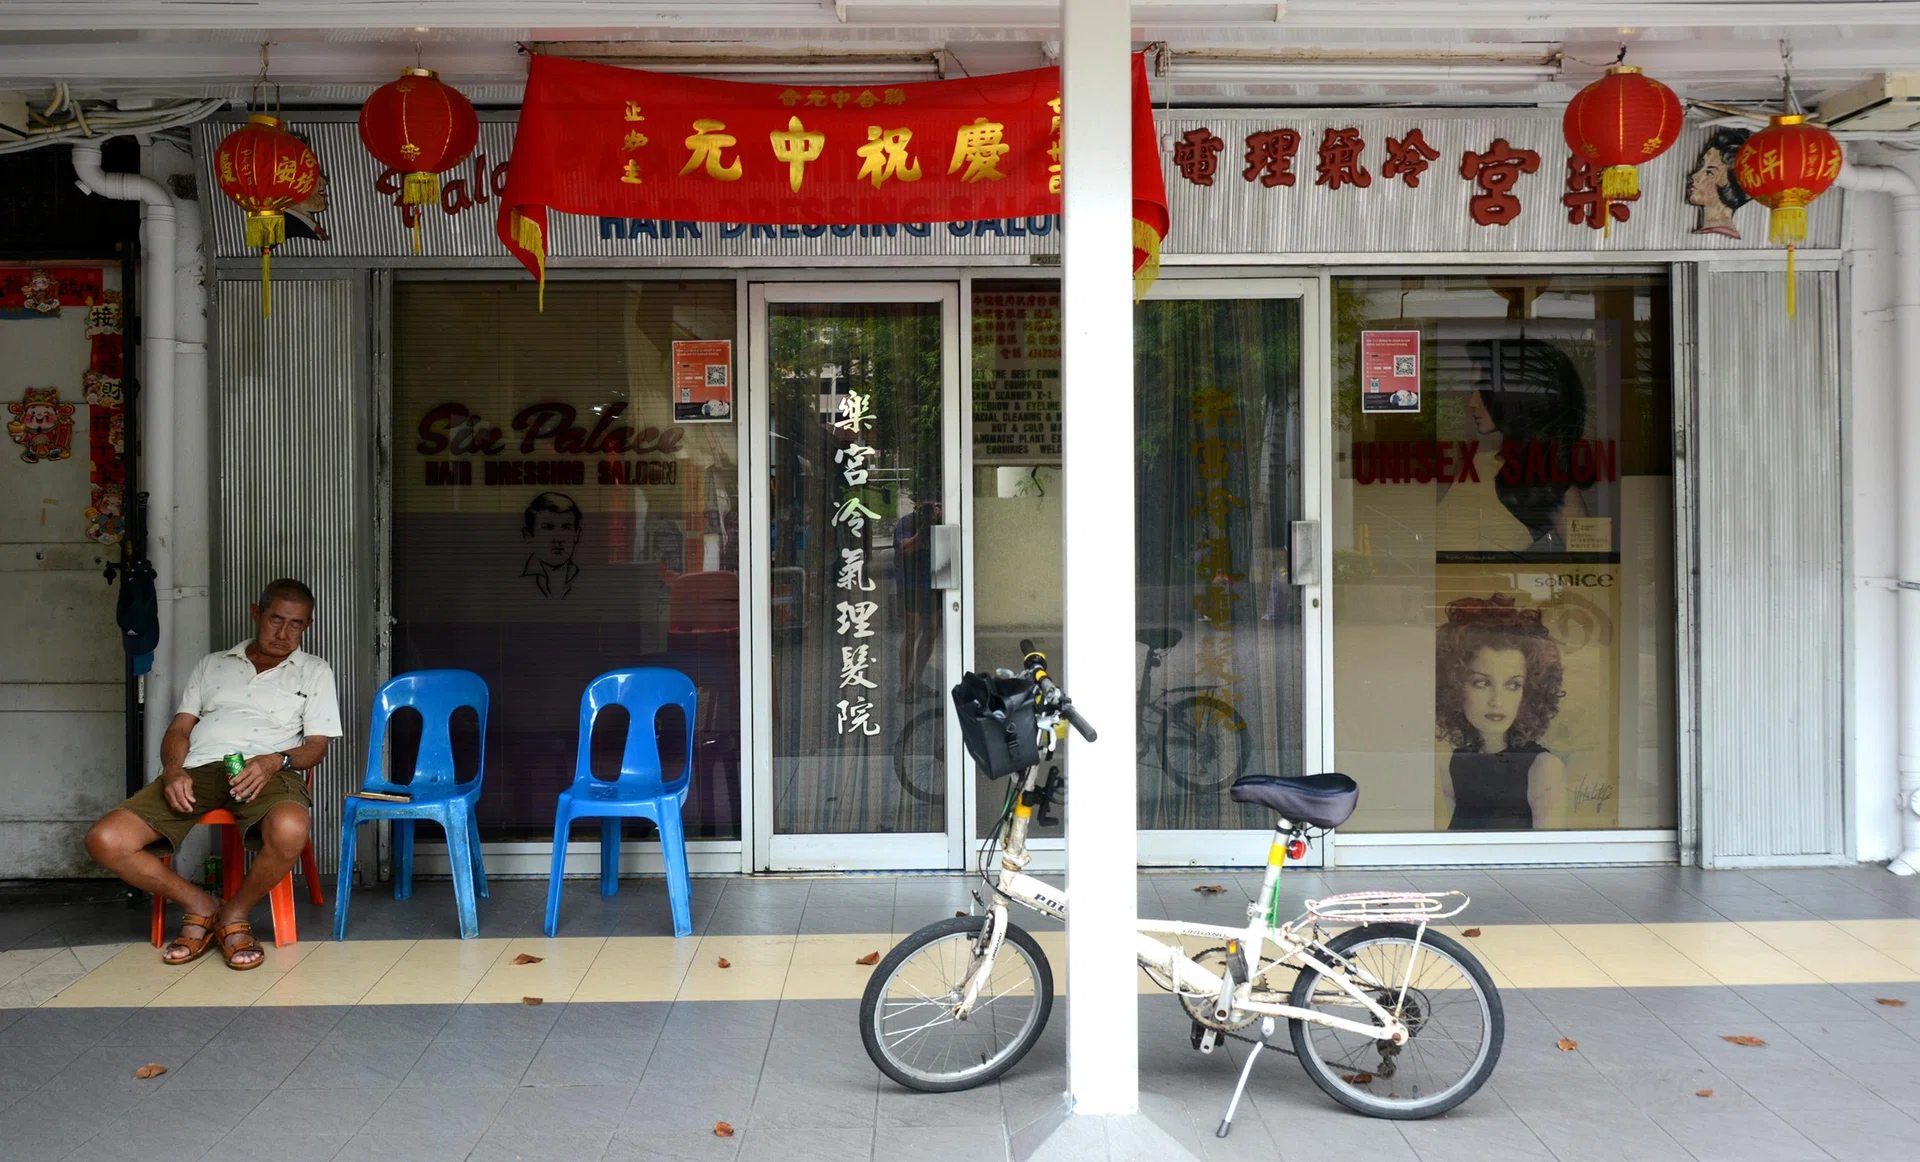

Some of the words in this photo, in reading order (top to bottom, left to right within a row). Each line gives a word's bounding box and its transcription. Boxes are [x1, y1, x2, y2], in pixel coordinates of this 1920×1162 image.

[92, 307, 114, 327] 接
[512, 402, 685, 455] Palace
[425, 461, 472, 486] HAIR
[485, 461, 585, 486] DRESSING
[597, 461, 677, 486] SALOON
[1354, 439, 1480, 485] UNISEX
[1501, 439, 1616, 484] SALON
[832, 390, 882, 736] 樂宮冷氣理髮院
[1535, 569, 1614, 588] sonice
